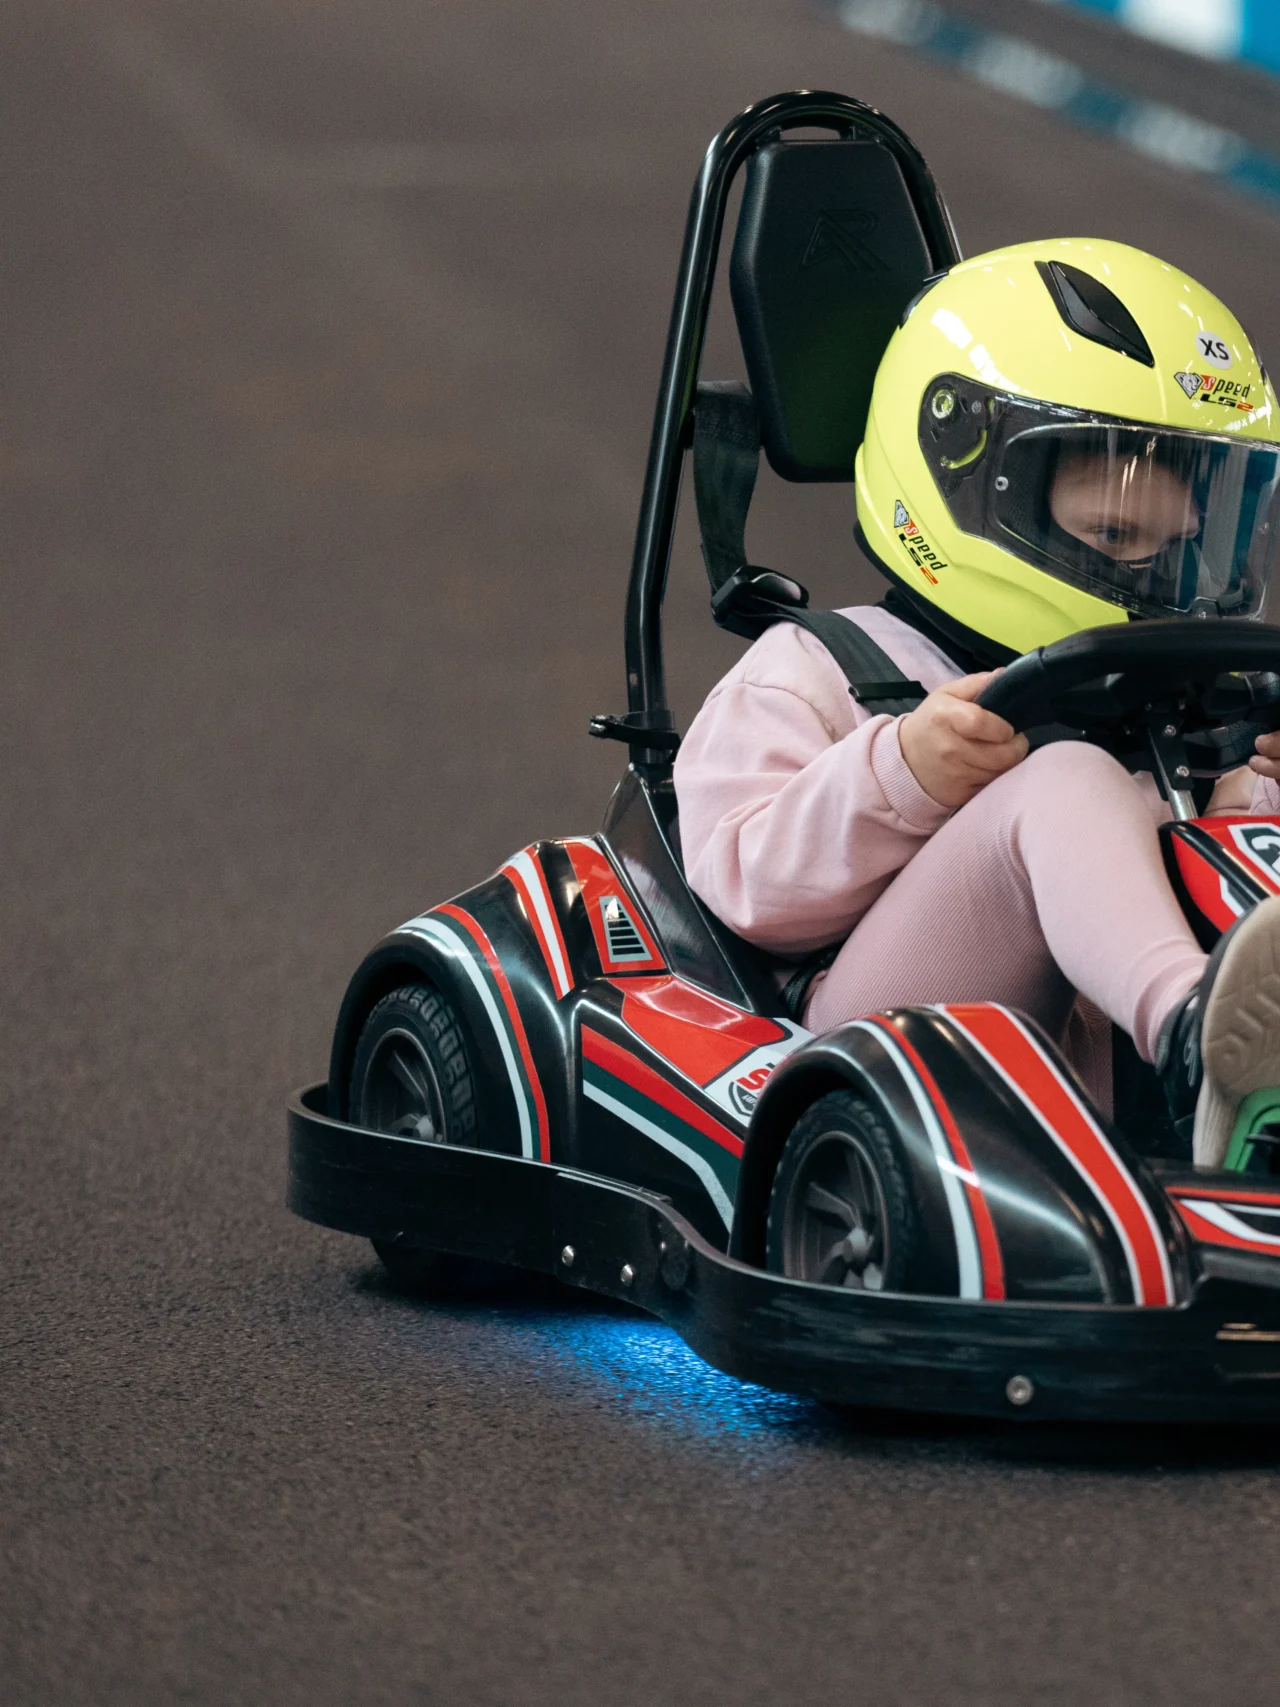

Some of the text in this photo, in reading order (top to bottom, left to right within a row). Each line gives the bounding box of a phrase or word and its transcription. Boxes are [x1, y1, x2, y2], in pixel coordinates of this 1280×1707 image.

[1199, 337, 1230, 361] XS
[1202, 375, 1251, 399] Speed
[1200, 393, 1255, 412] LS2
[904, 521, 948, 571] Speed
[899, 532, 939, 586] LS2
